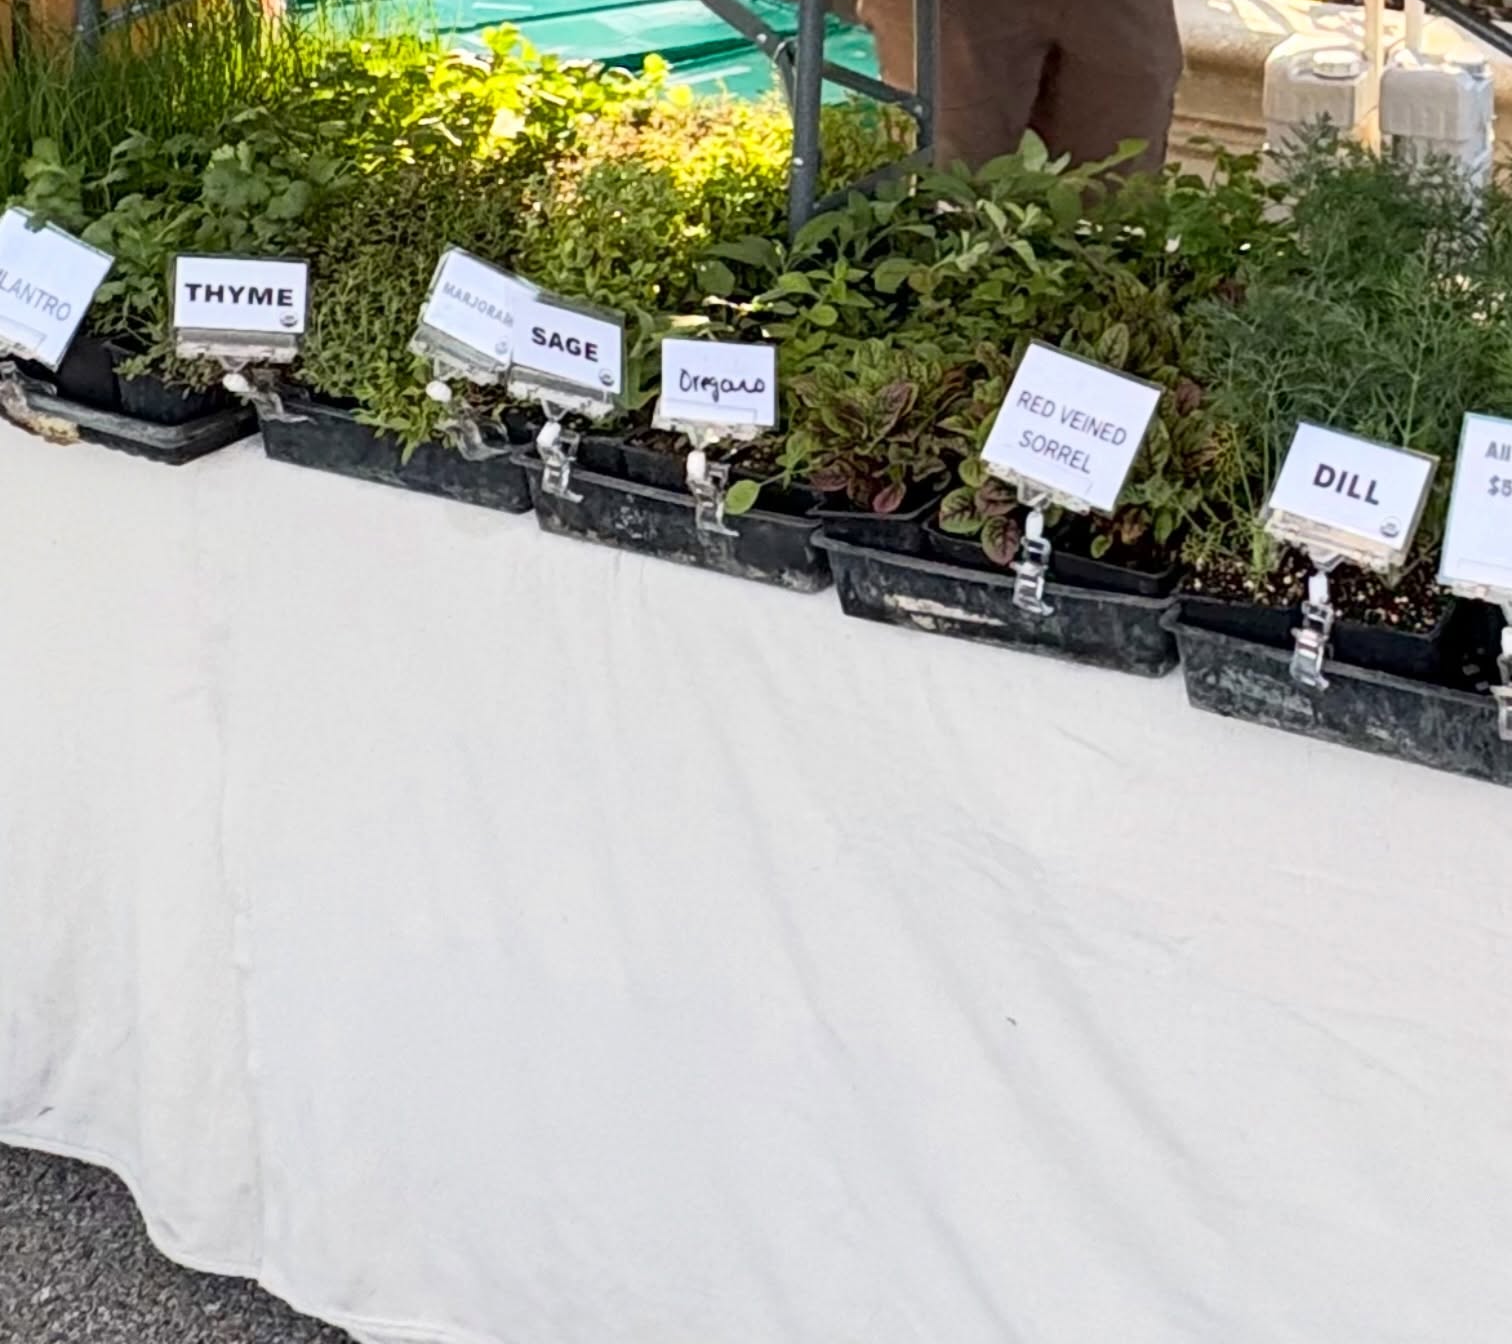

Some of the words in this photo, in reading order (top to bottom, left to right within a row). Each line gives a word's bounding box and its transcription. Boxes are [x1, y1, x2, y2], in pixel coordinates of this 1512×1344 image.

[0, 268, 71, 321] LANTRO
[185, 283, 293, 308] THYME
[531, 326, 599, 362] SAGE
[679, 368, 766, 403] Oregano
[1016, 390, 1056, 419] RED
[1060, 405, 1128, 446] VEINED
[1019, 429, 1092, 474] SORREL
[1484, 442, 1512, 461] All
[1312, 463, 1380, 506] DILL
[1487, 475, 1512, 498] $5
